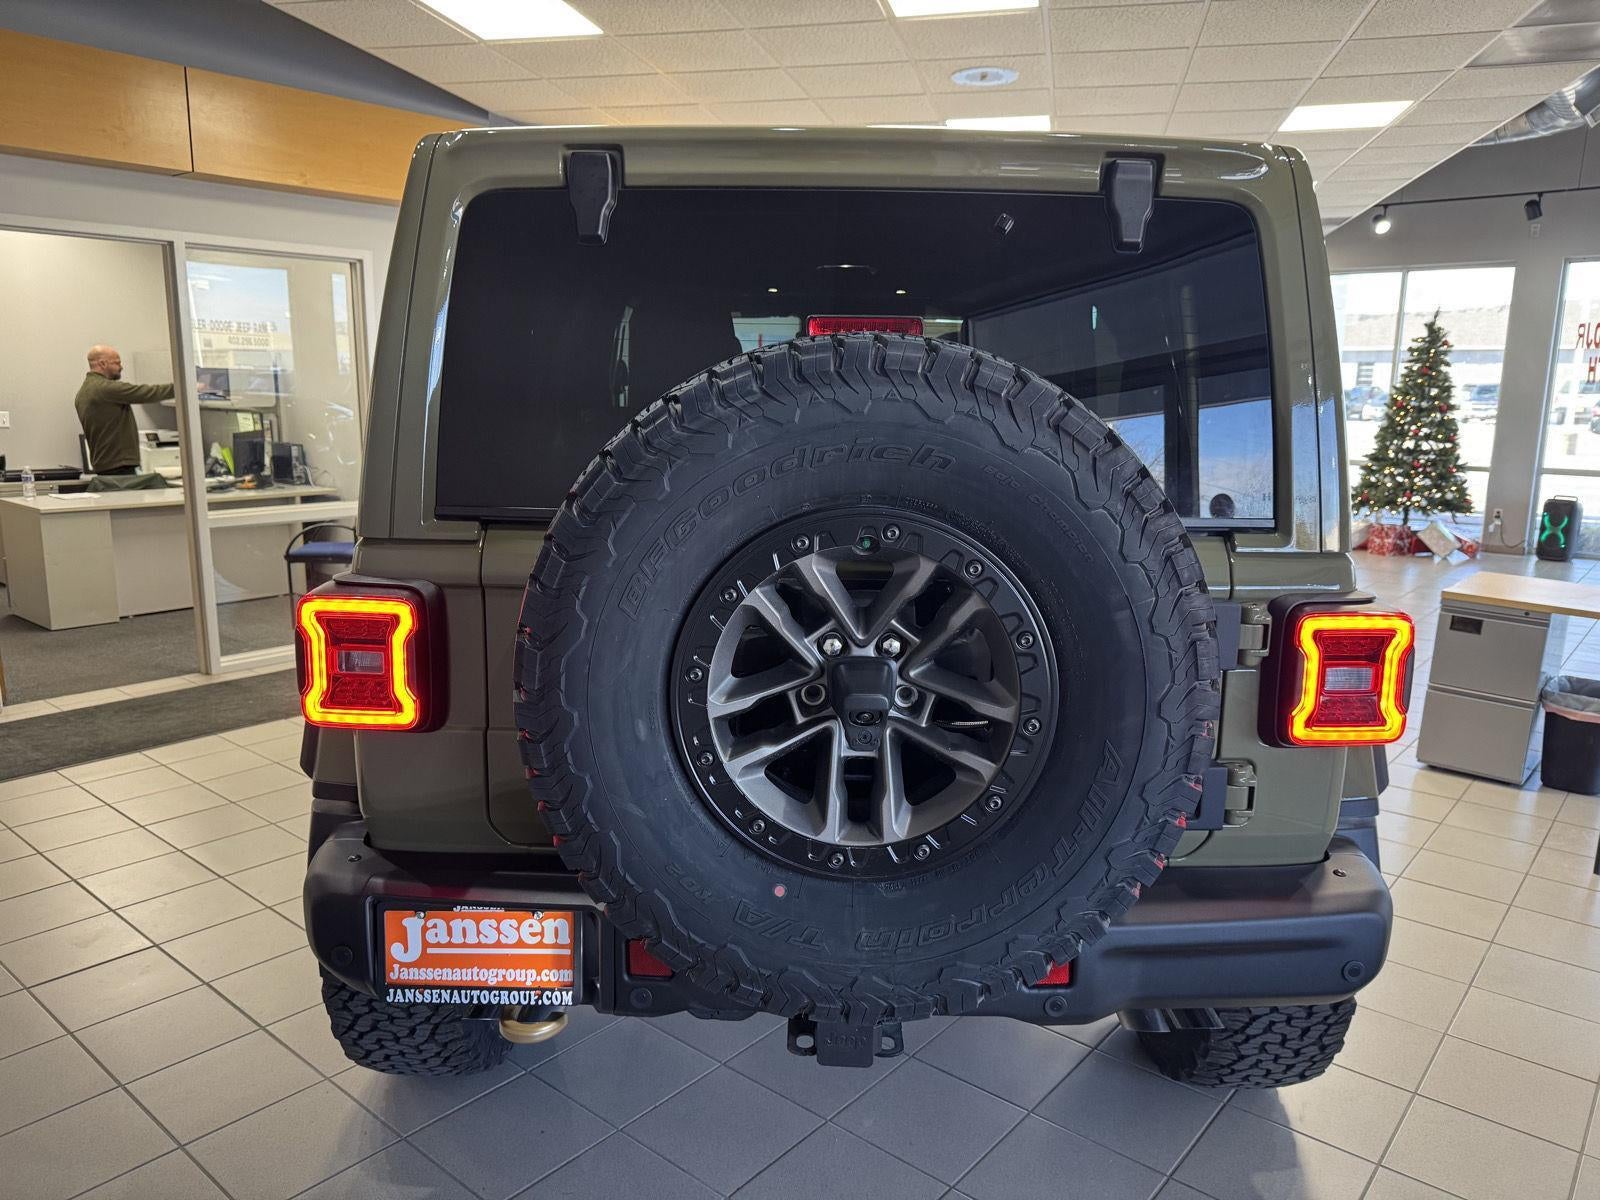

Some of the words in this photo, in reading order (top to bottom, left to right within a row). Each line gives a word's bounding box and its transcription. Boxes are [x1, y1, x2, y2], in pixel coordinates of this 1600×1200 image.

[618, 437, 957, 621] BFGoodrich
[390, 917, 570, 962] Janssen
[389, 963, 573, 985] Janssenautogroup.com
